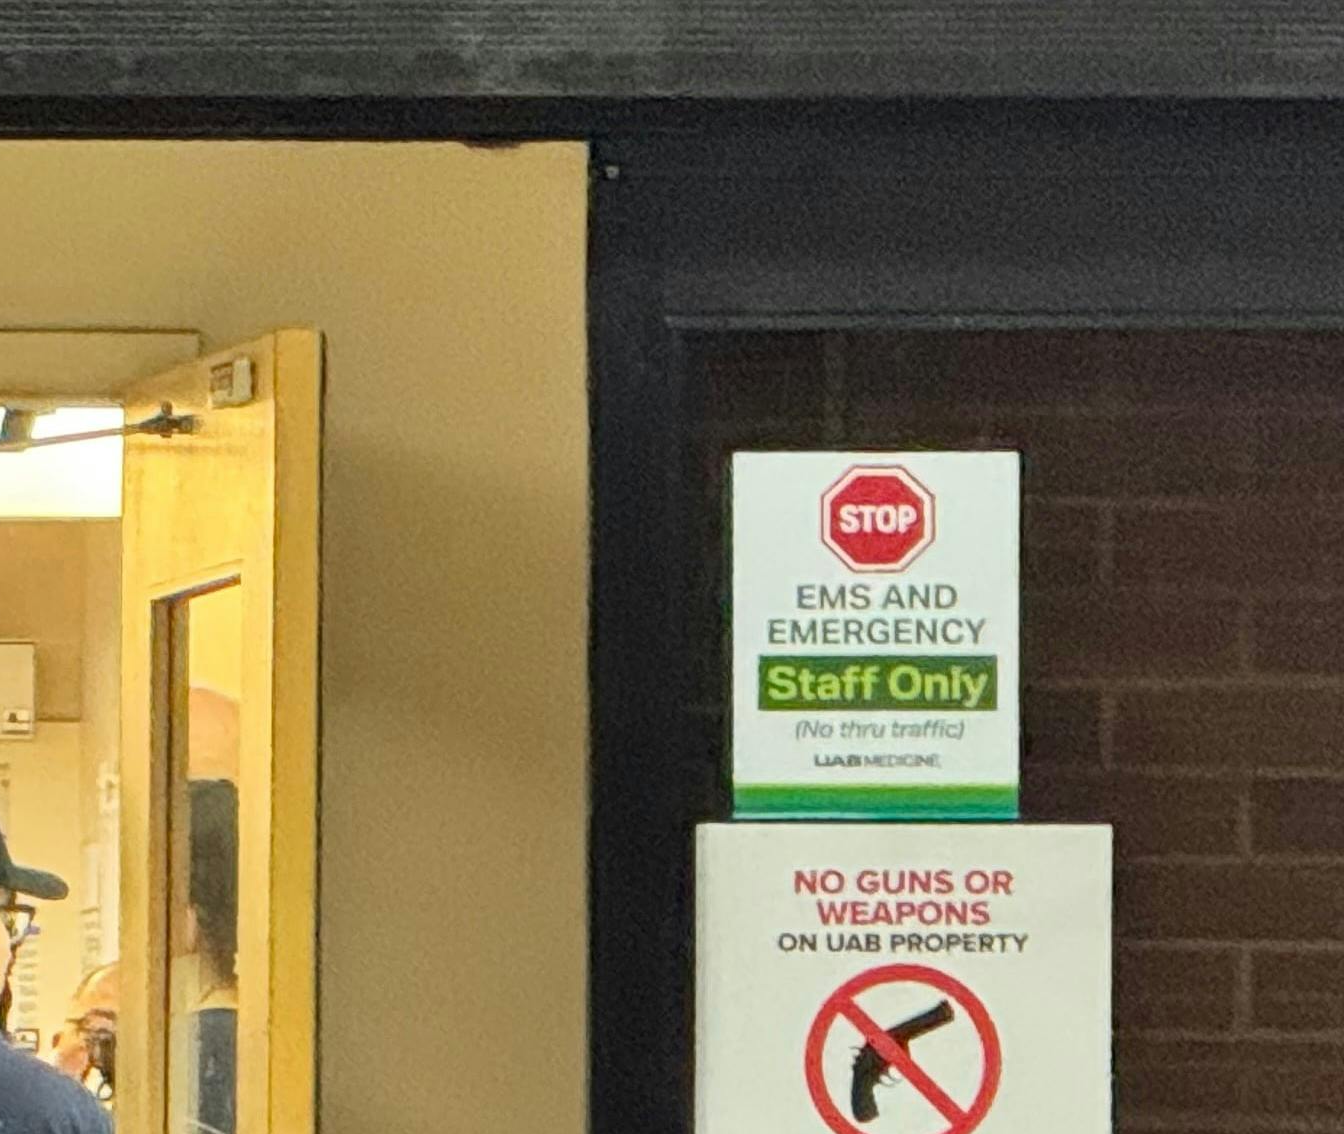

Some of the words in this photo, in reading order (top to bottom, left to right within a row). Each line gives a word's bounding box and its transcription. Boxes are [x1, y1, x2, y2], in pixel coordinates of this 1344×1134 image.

[839, 504, 917, 534] STOP
[796, 584, 871, 611] EMS
[882, 584, 958, 610] AND
[768, 618, 987, 645] EMERGENCY
[767, 665, 880, 701] Staff
[889, 665, 989, 709] Only
[796, 720, 834, 741] (No
[840, 720, 886, 739] thru
[891, 719, 965, 741] traffic)
[794, 870, 844, 895] NO
[856, 870, 954, 895] GUNS
[965, 870, 1013, 895] OR
[817, 901, 990, 926] WEAPONS
[778, 933, 817, 953] ON
[827, 933, 880, 953] UAB
[890, 933, 1029, 953] PROPERTY
